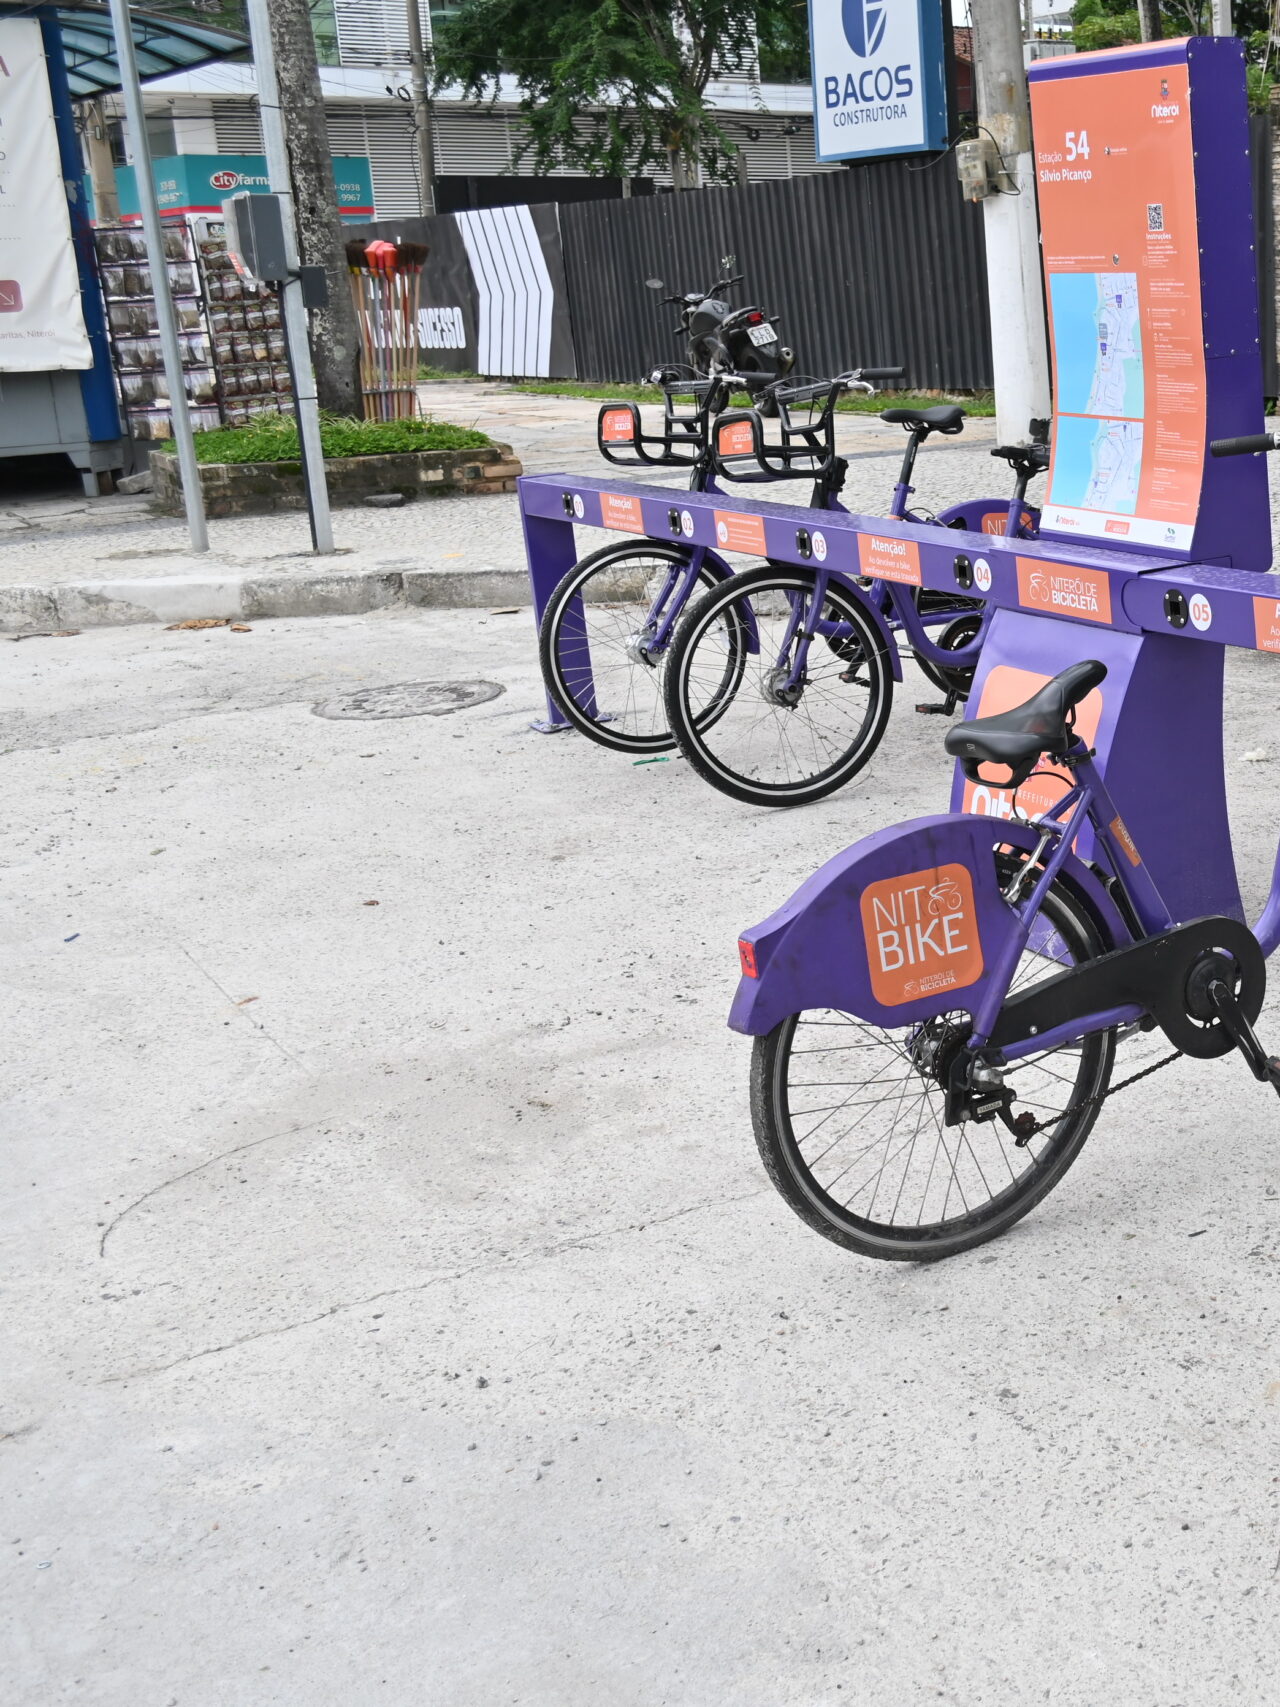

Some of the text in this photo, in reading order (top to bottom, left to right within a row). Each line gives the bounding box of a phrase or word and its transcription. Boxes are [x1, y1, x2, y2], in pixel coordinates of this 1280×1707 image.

[824, 64, 913, 109] BACOS
[833, 104, 907, 127] CONSTRUTORA
[1038, 152, 1062, 165] Estação
[1065, 131, 1090, 162] 54
[1040, 168, 1092, 183] Sílvio Picanço
[682, 517, 693, 531] 02
[814, 539, 826, 554] 03
[871, 538, 906, 557] Atenção!
[976, 567, 990, 584] 04
[1050, 575, 1097, 598] NITERÓI DE
[1051, 590, 1099, 612] BICICLETA
[1192, 603, 1210, 622] 05
[1270, 625, 1280, 636] Ao
[872, 885, 926, 931] NIT
[877, 911, 968, 972] BIKE
[921, 977, 957, 992] BICICLETA
